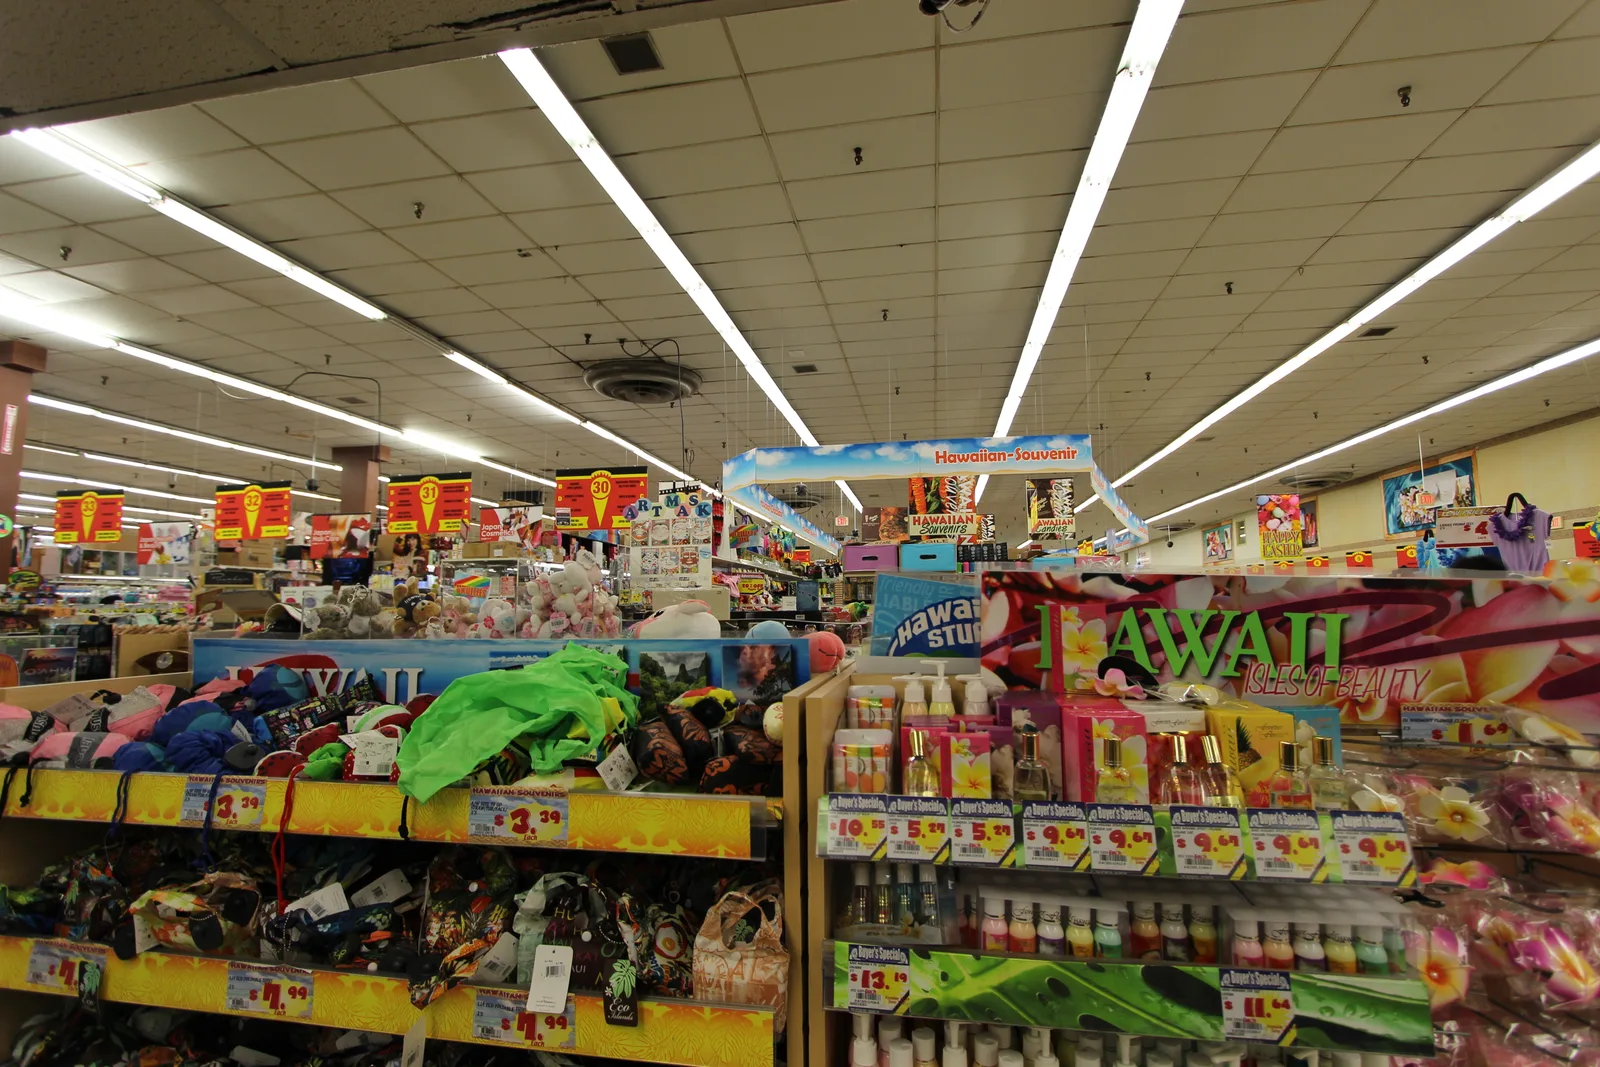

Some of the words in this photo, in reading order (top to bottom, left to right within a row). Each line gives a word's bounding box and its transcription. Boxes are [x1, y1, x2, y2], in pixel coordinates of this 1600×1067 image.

[422, 486, 436, 499] 31
[592, 481, 609, 494] 30
[246, 495, 259, 507] 32
[1420, 495, 1432, 504] EXIT
[83, 500, 95, 513] 33
[912, 514, 974, 526] HAWAIIAN
[1037, 518, 1074, 527] AWAIIAN
[481, 524, 502, 532] Japan
[919, 522, 968, 535] Souvenirs
[1262, 530, 1300, 543] HAPPY
[1263, 543, 1303, 557] EASTER
[1244, 663, 1302, 696] ISLES
[1304, 665, 1336, 697] OF
[1336, 667, 1431, 700] BEAUTY
[1402, 705, 1452, 713] HAWAIIAN
[1431, 729, 1444, 740] $
[225, 776, 267, 785] SOUVENIRS
[472, 787, 515, 796] HAWAIIAN
[517, 789, 567, 798] SOUVENIRS
[494, 814, 504, 827] $
[523, 833, 538, 841] Each
[249, 989, 258, 1001] $
[479, 988, 523, 1001] HAWAIIAN
[608, 997, 631, 1013] Eco
[501, 1018, 511, 1031] $
